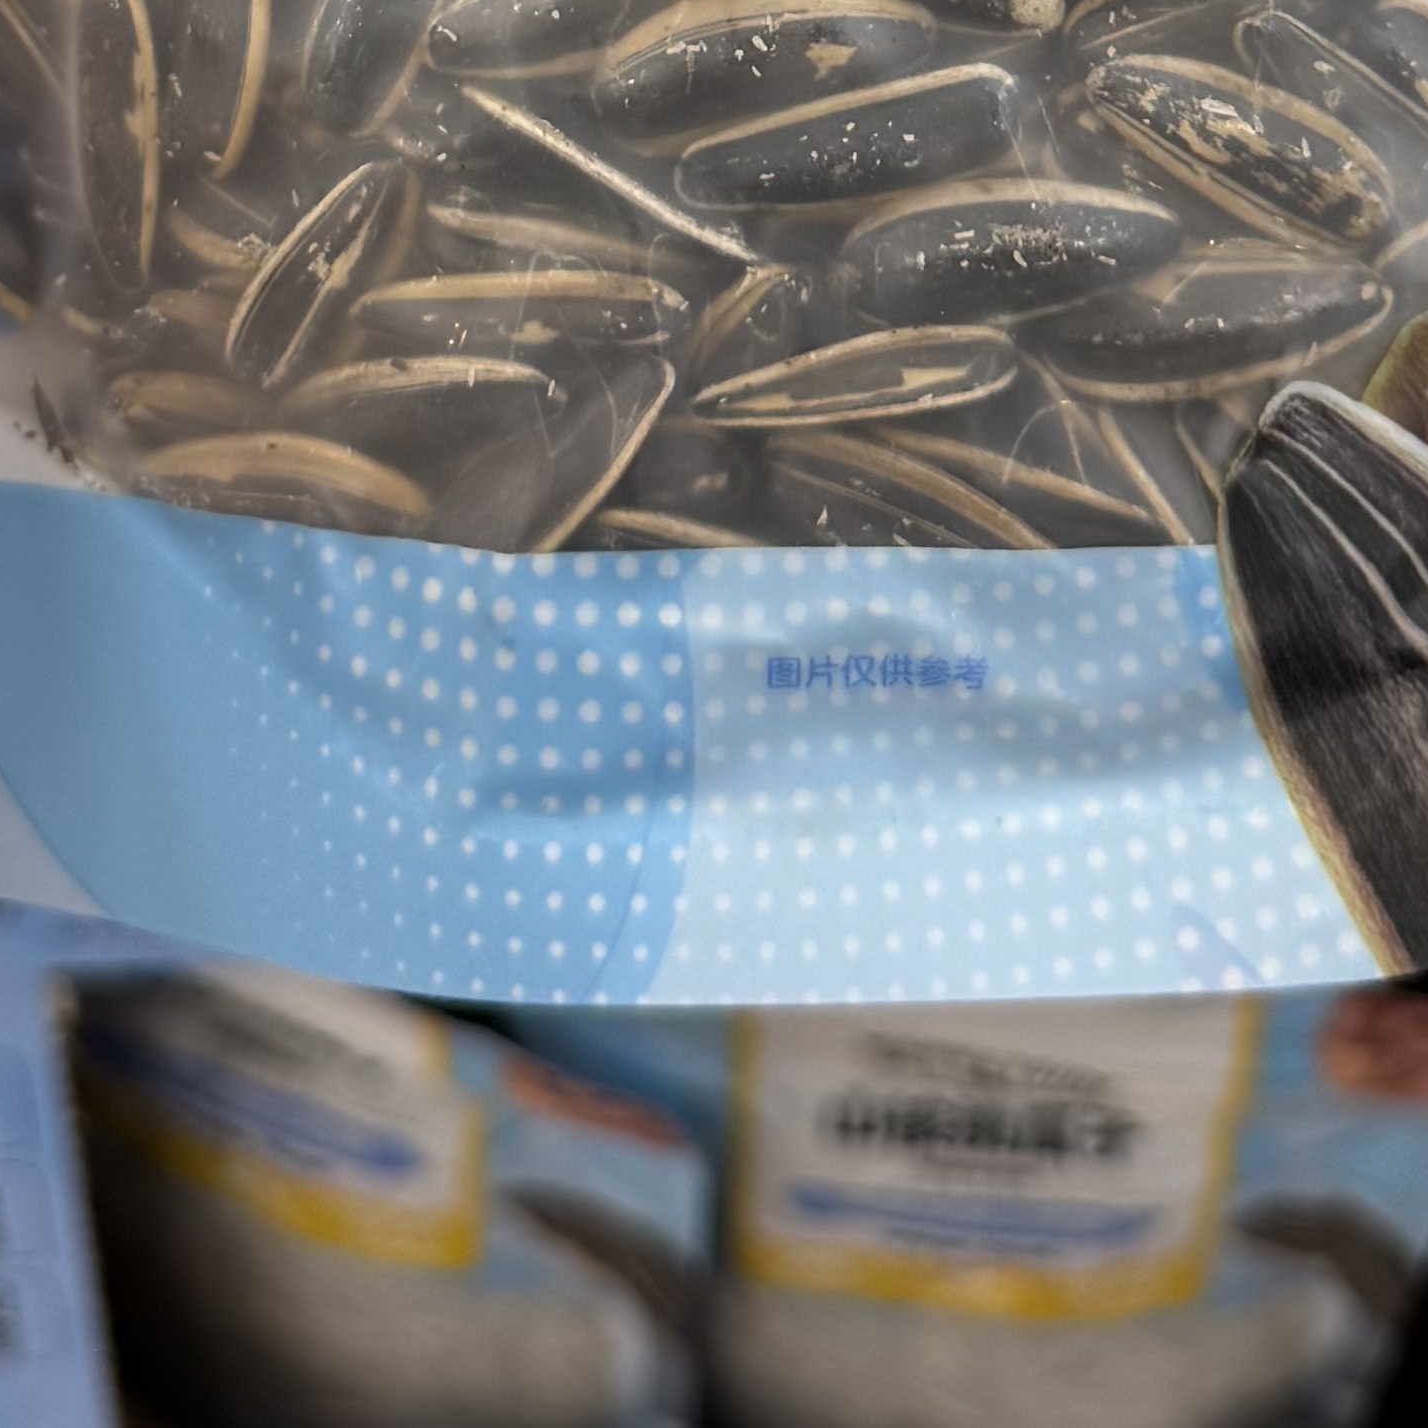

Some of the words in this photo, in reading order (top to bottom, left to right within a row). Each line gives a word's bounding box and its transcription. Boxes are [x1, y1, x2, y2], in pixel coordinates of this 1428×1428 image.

[767, 654, 988, 690] 图片仅供参考
